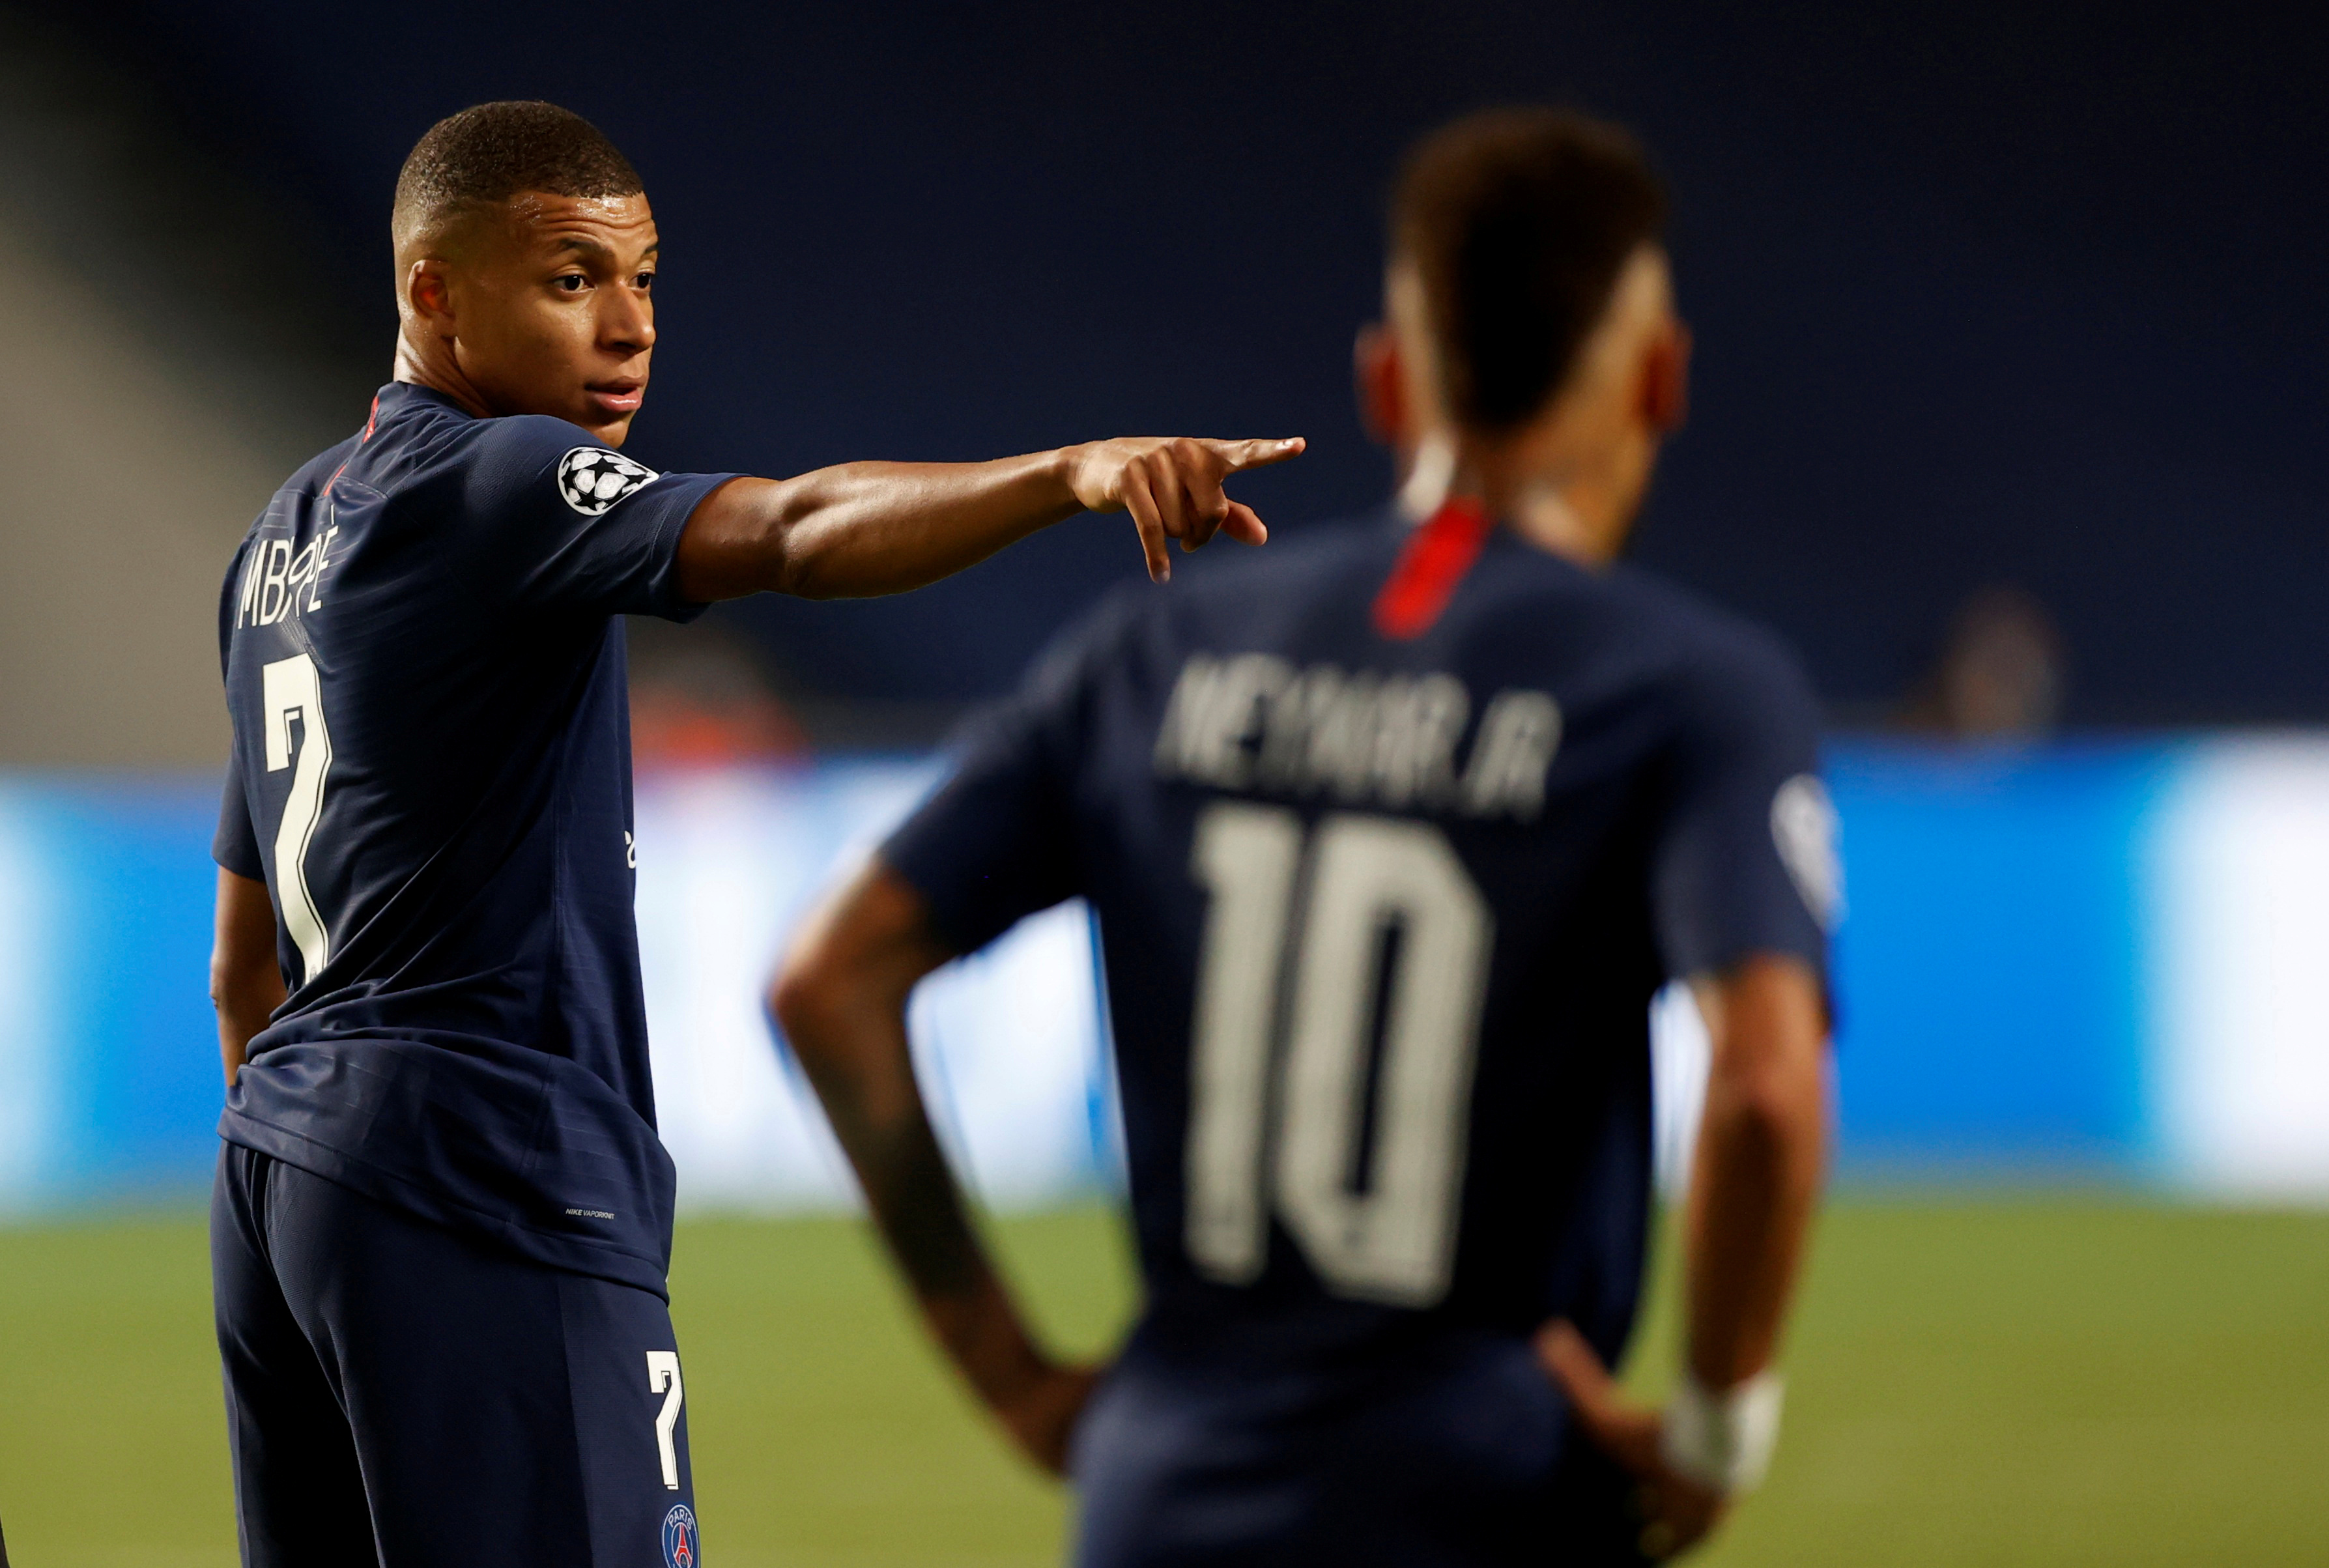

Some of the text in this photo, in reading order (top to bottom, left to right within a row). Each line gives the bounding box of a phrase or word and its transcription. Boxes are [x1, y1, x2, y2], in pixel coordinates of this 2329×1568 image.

[263, 653, 332, 985] 7
[1182, 799, 1495, 1307] 10
[583, 1210, 615, 1219] VAPORKNIT
[646, 1350, 683, 1490] 7
[668, 1509, 693, 1530] PARIS
